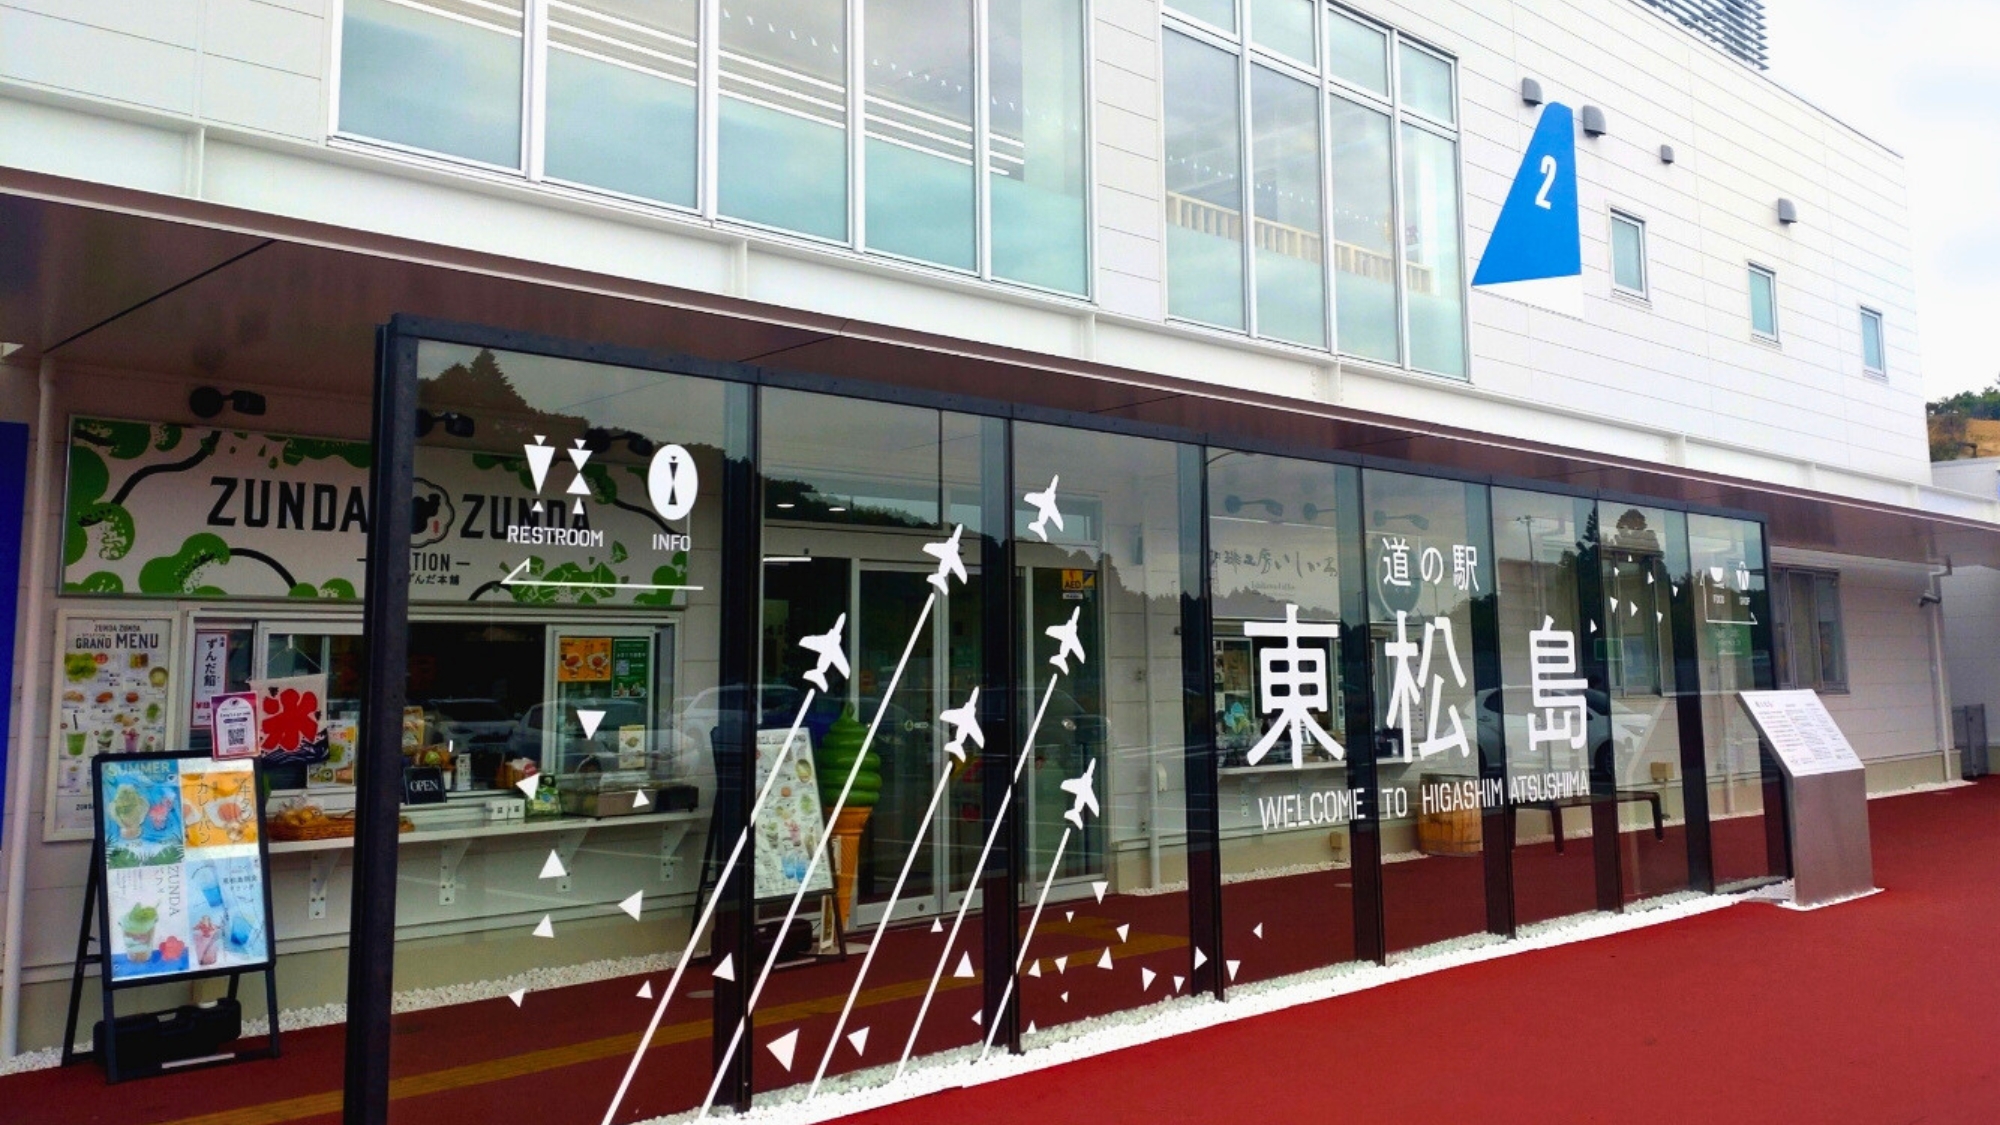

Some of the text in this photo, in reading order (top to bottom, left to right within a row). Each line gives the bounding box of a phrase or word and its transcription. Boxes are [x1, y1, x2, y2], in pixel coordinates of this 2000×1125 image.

[1534, 153, 1558, 210] 2
[206, 476, 591, 542] ZUNDA ZUNDA
[507, 525, 604, 548] RESTROOM
[652, 533, 692, 552] INFO
[410, 552, 451, 572] TION
[1382, 536, 1479, 592] 道の駅
[1065, 580, 1082, 589] AED
[75, 633, 159, 649] GRAND MENU
[1243, 603, 1590, 769] 東松島
[261, 688, 319, 752] 氷
[108, 762, 171, 777] SUMMER
[409, 779, 439, 792] OPEN
[1258, 787, 1366, 831] WELCOME
[1381, 787, 1407, 819] TO
[167, 865, 181, 917] ZUNDA
